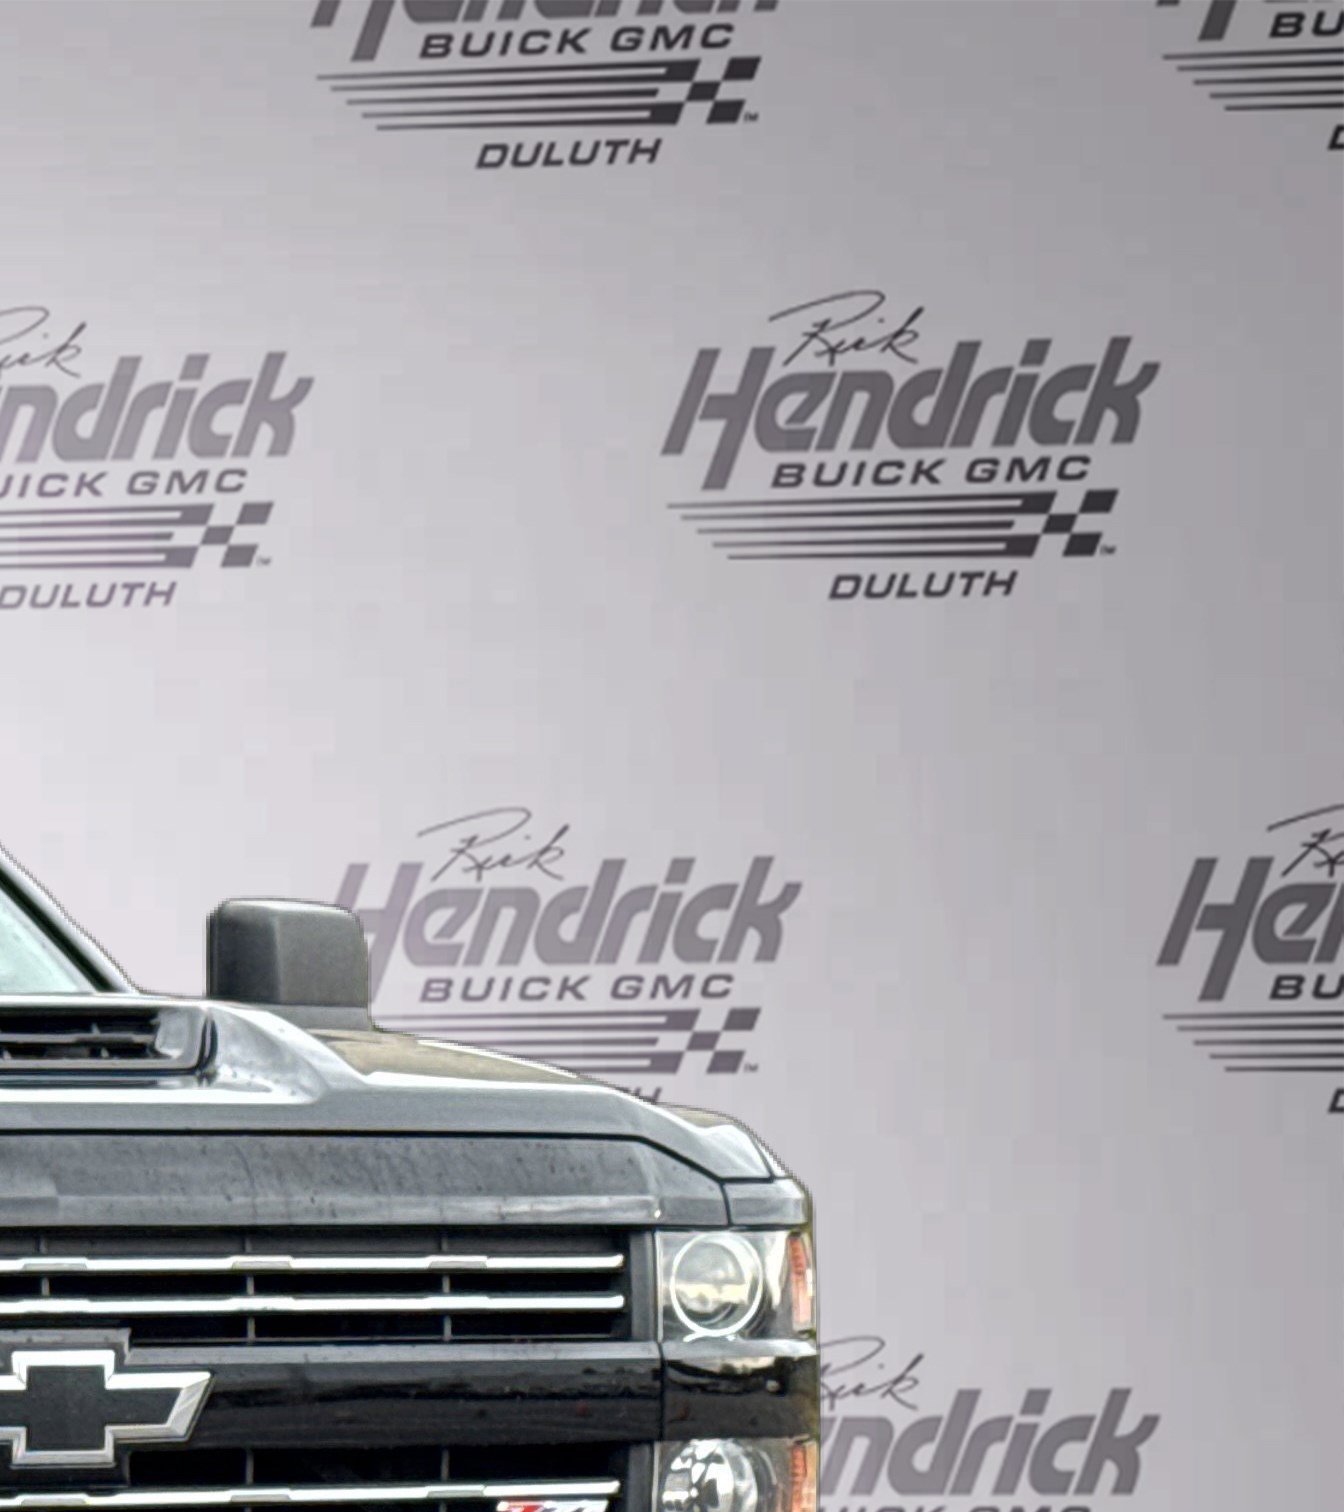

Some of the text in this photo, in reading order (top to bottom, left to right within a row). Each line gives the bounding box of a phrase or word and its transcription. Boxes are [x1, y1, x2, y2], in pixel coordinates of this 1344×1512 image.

[418, 28, 593, 59] BUICK
[610, 23, 736, 52] GMC
[474, 138, 663, 169] DULUTH
[660, 335, 1161, 490] Hendrick
[126, 468, 249, 497] GMC
[770, 455, 1092, 489] BUICK GMC
[827, 570, 1019, 600] DULUTH
[334, 856, 803, 1004] Hendrick
[419, 973, 736, 1004] BUICK GMC
[819, 1387, 1162, 1497] ndrick
